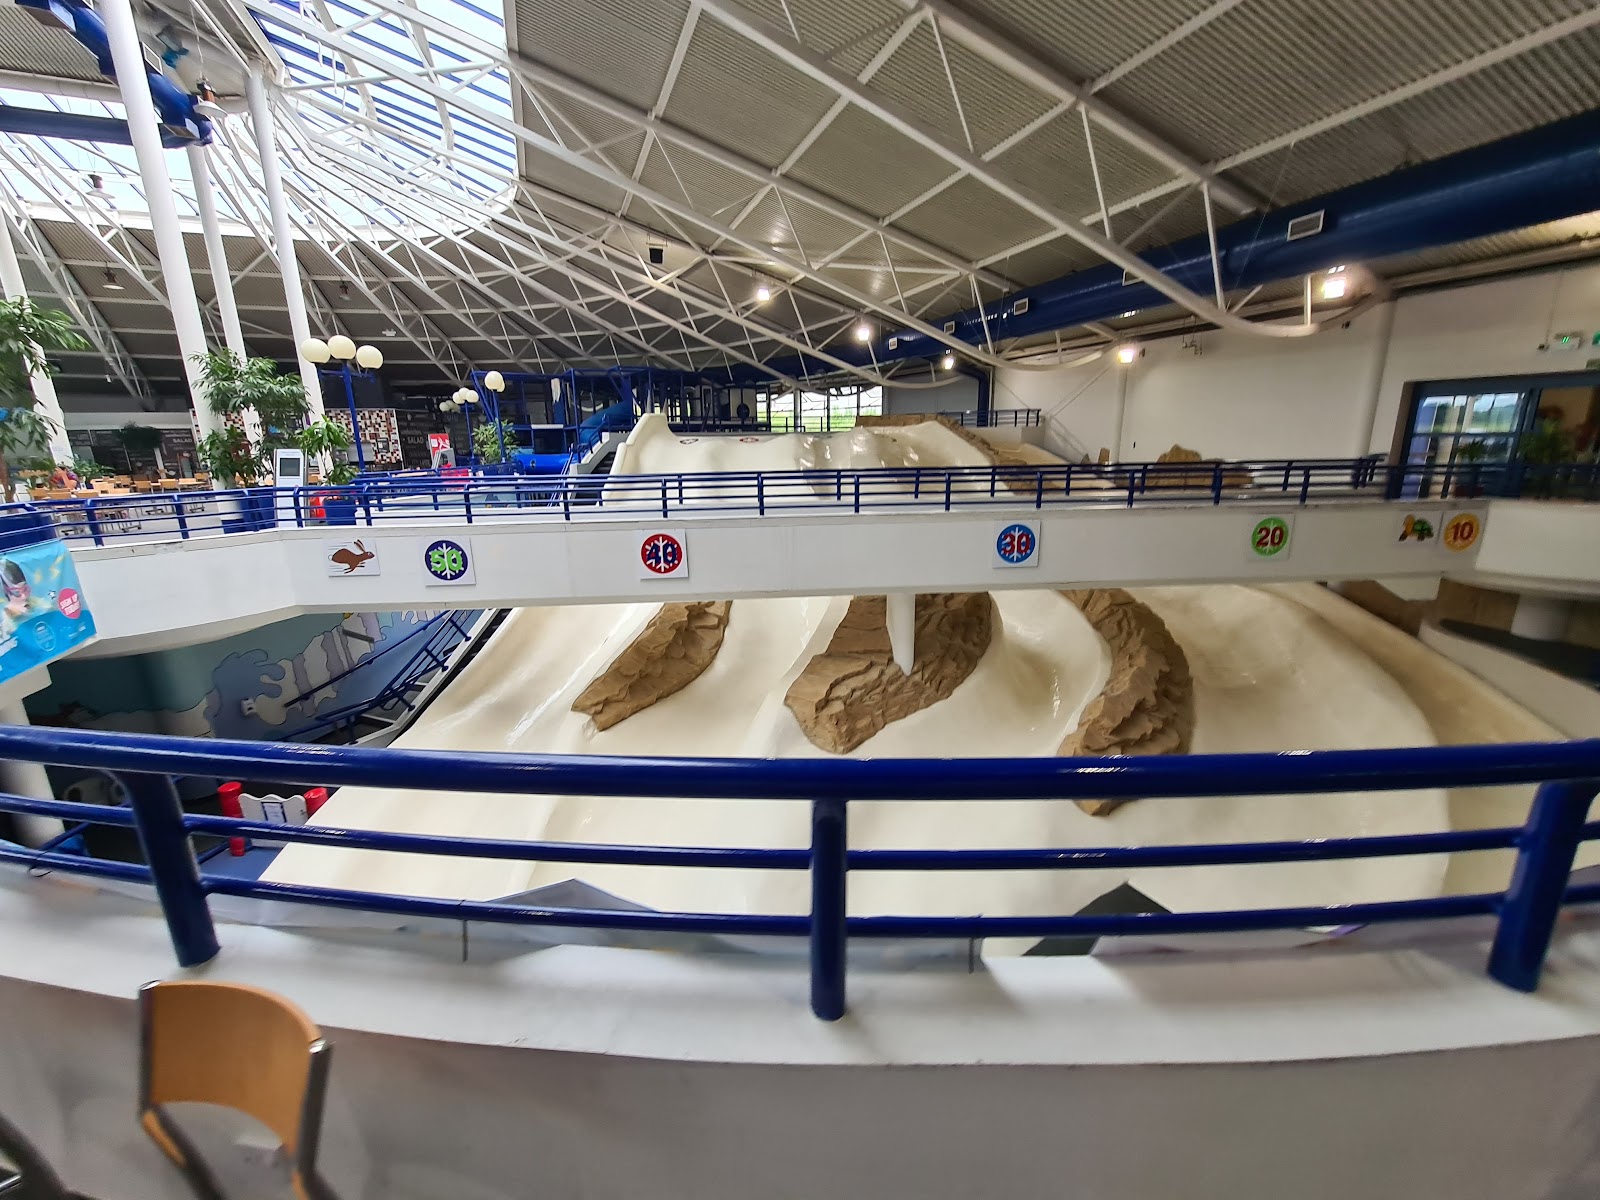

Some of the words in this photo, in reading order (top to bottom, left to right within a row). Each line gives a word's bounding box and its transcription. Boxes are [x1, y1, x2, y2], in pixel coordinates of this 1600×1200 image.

[407, 436, 424, 445] SALAD
[1256, 526, 1284, 547] 20
[1452, 521, 1473, 541] 10
[647, 542, 677, 564] 40
[1002, 533, 1030, 554] 30
[431, 550, 463, 571] 50
